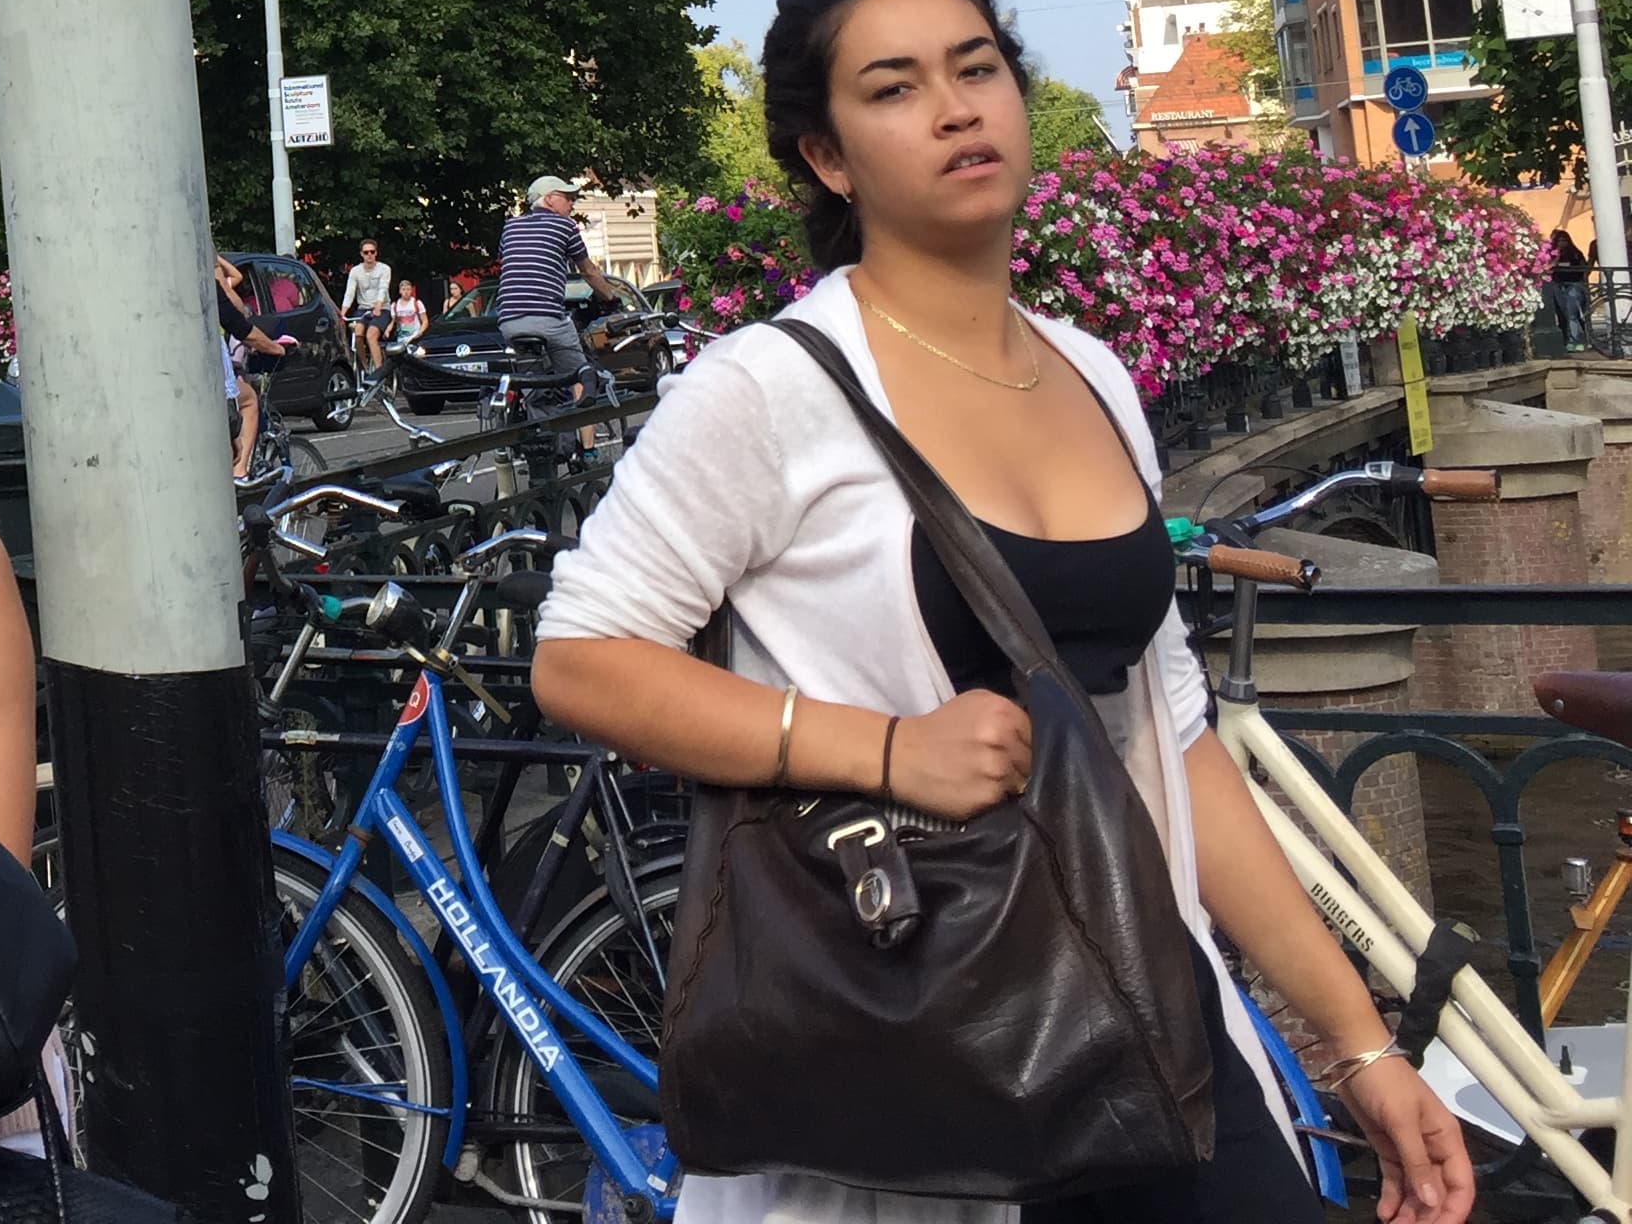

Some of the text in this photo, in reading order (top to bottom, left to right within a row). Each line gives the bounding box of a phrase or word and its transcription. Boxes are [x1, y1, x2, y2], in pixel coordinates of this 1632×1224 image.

[1151, 109, 1215, 121] RESTAURANT
[1310, 882, 1374, 952] BURGERS
[427, 878, 560, 1072] HOLLANDIA
